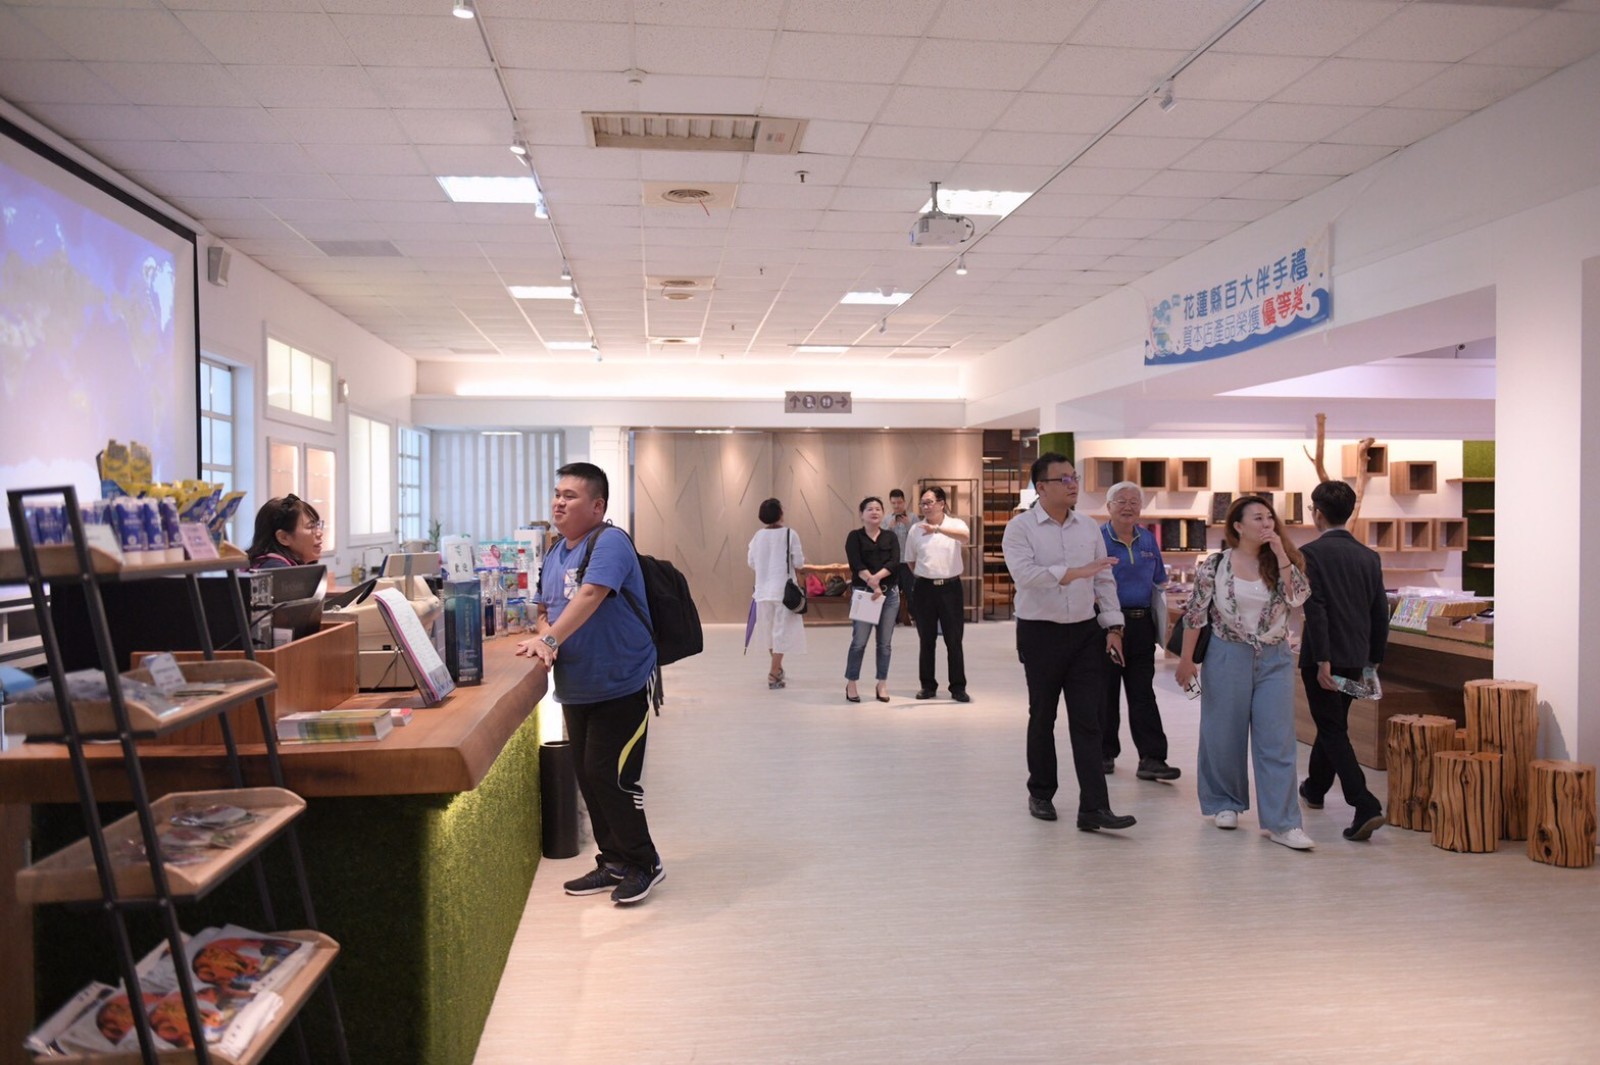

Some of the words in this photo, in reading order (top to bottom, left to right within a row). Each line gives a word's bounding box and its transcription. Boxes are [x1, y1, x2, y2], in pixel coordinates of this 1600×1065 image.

[1183, 247, 1309, 321] 花蓮縣百大伴手禮
